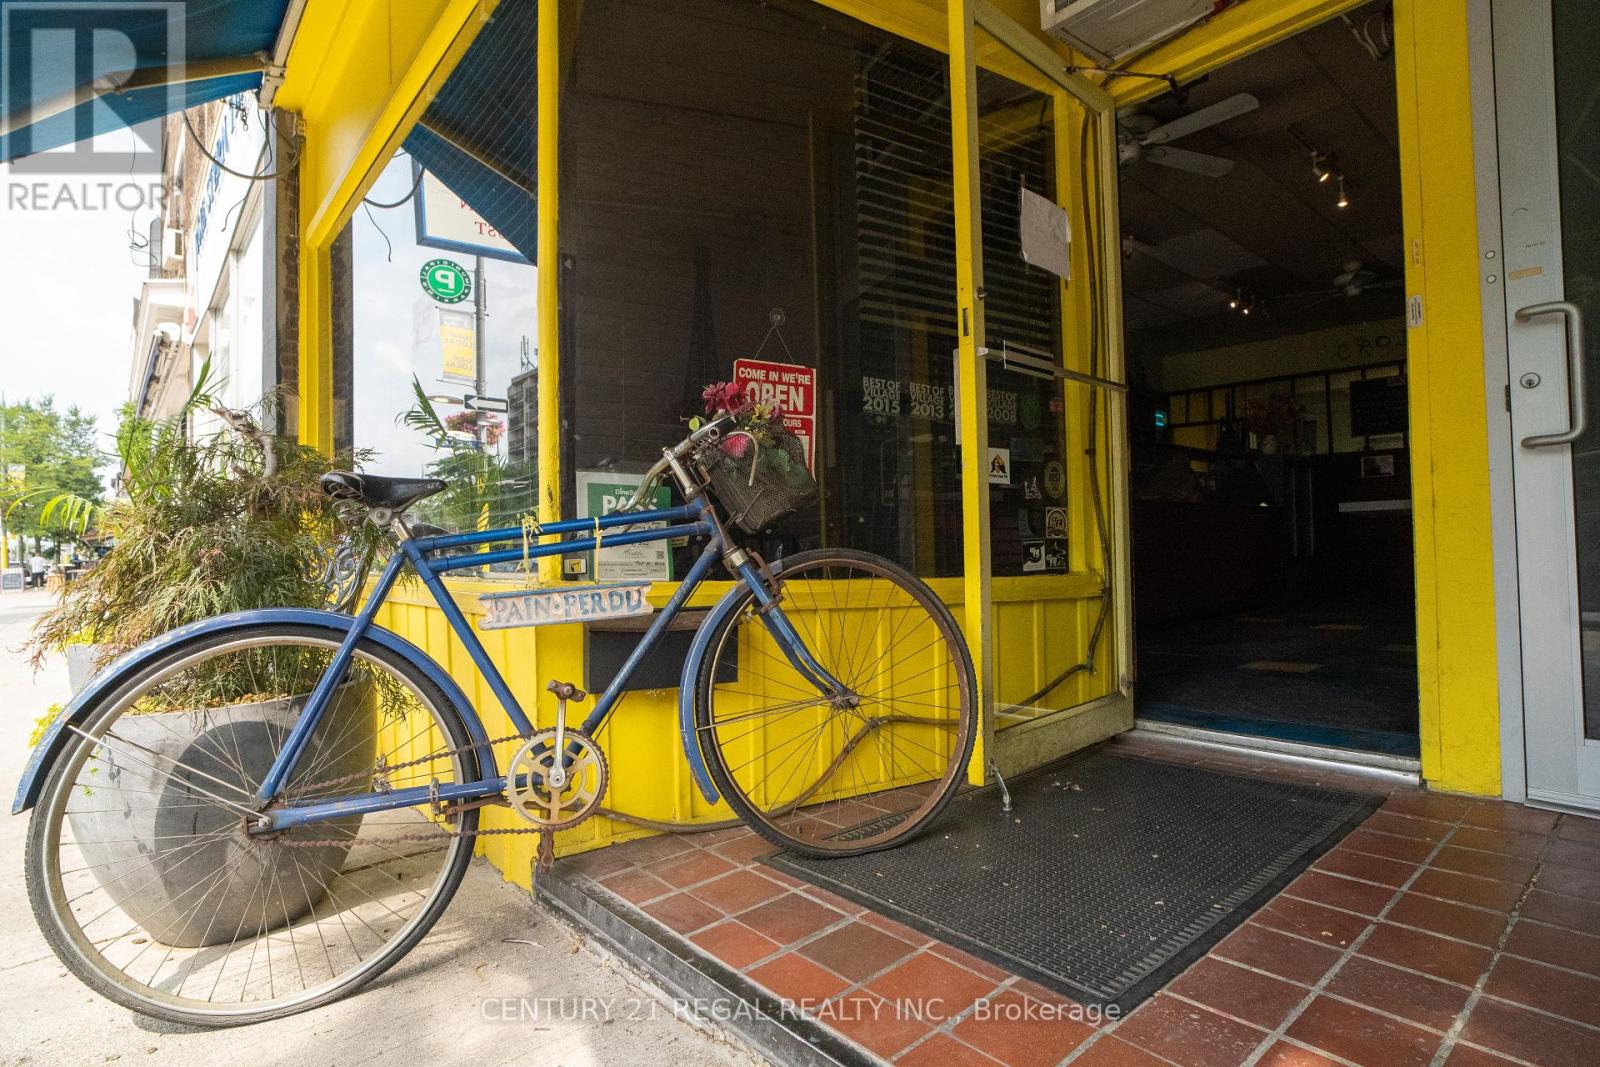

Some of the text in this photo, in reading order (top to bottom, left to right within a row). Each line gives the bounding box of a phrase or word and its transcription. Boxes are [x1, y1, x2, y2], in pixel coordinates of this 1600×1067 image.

[738, 367, 811, 384] COME IN WE'RE
[863, 376, 900, 391] BEST OF
[910, 382, 944, 397] BEST OF
[745, 381, 804, 412] OPEN
[864, 386, 900, 400] VILLAGE
[911, 391, 944, 406] VILLAGE
[863, 397, 900, 416] 2015
[911, 402, 944, 419] 2013
[782, 419, 802, 428] OURS
[615, 487, 636, 496] DineS
